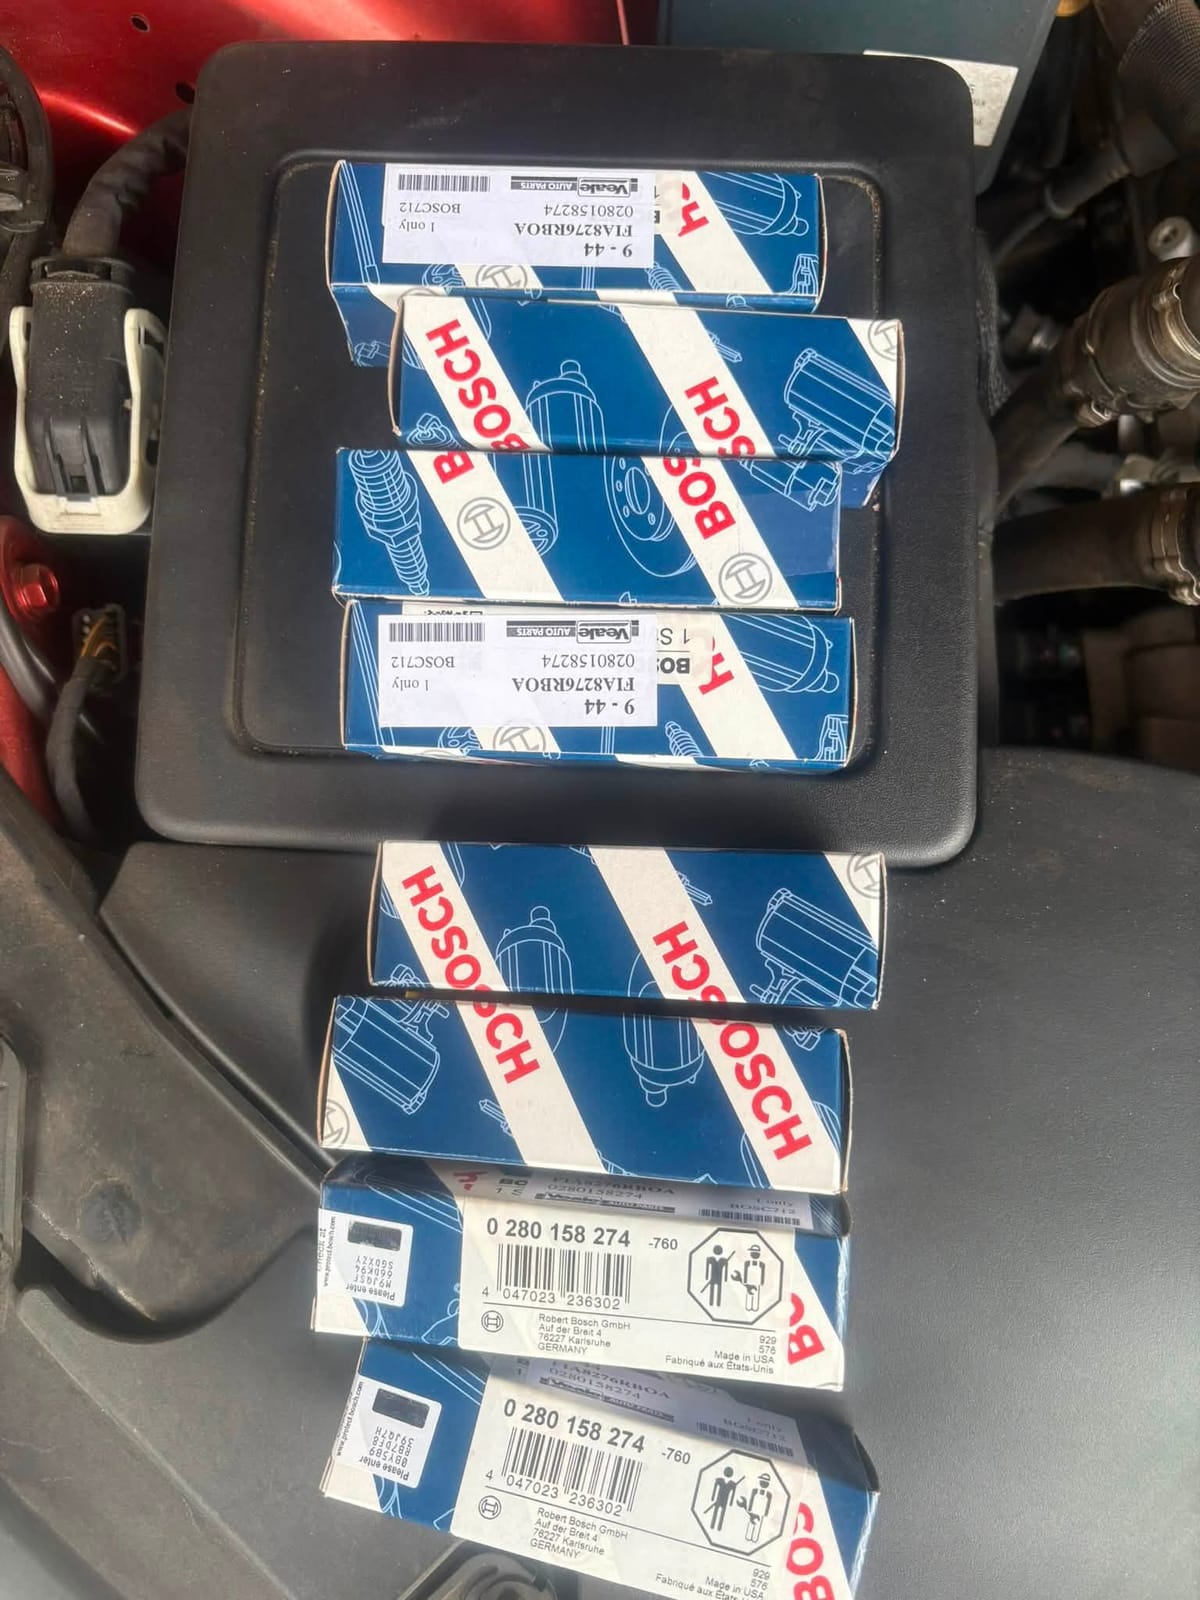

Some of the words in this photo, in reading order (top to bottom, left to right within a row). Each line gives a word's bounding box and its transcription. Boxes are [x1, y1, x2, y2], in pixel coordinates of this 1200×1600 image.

[520, 182, 545, 190] PARTS
[546, 182, 573, 191] AUTO
[581, 179, 629, 195] Veale
[399, 202, 461, 214] BOSC712
[543, 204, 634, 218] 0280158274
[399, 219, 426, 232] only
[514, 222, 633, 237] FIA8276RBOA
[584, 242, 606, 256] 44
[622, 243, 633, 257] 9
[517, 627, 541, 637] PARTS
[542, 627, 571, 637] AUTO
[578, 625, 630, 641] Veale
[391, 655, 455, 669] BOSC712
[541, 653, 635, 668] 0280158274
[391, 677, 419, 691] only
[511, 677, 635, 692] FIA8276RBOA
[584, 699, 606, 715] 44
[624, 701, 635, 716] 9
[486, 1217, 499, 1236] 0
[505, 1219, 542, 1239] 280
[549, 1222, 586, 1244] 158
[592, 1226, 631, 1247] 274
[648, 1237, 678, 1250] -760
[345, 1282, 368, 1294] enter
[369, 1288, 396, 1301] Please
[482, 1288, 490, 1298] 4
[503, 1288, 556, 1304] 047023
[566, 1295, 621, 1310] 236302
[538, 1313, 569, 1326] Robert
[571, 1316, 599, 1328] Bosch
[601, 1319, 631, 1330] GmbH
[538, 1323, 553, 1333] Auf
[555, 1325, 571, 1335] der
[573, 1326, 594, 1337] Breit
[538, 1332, 568, 1344] 76227
[569, 1335, 611, 1348] Karlsruhe
[759, 1335, 777, 1345] 929
[537, 1342, 588, 1355] GERMANY
[713, 1350, 740, 1361] Made
[742, 1352, 751, 1361] in
[753, 1353, 775, 1364] USA
[665, 1355, 706, 1368] Fabriqué
[707, 1361, 724, 1370] aux
[726, 1360, 775, 1375] États-Unis
[503, 1397, 517, 1418] 0
[521, 1403, 560, 1430] 280
[566, 1415, 603, 1442] 158
[607, 1426, 646, 1454] 274
[358, 1455, 381, 1469] enter
[660, 1446, 691, 1465] -760
[382, 1462, 410, 1481] Please
[485, 1469, 494, 1482] 4
[505, 1473, 559, 1500] 047023
[568, 1492, 623, 1518] 236302
[535, 1517, 550, 1530] Auf
[552, 1521, 566, 1534] der
[568, 1525, 590, 1540] Breit
[537, 1506, 568, 1525] Robert
[569, 1513, 599, 1530] Bosch
[599, 1523, 629, 1541] GmbH
[530, 1538, 581, 1560] GERMANY
[532, 1527, 563, 1543] 76227
[565, 1535, 605, 1557] Karlsruhe
[655, 1572, 696, 1592] Fabriqué
[696, 1585, 714, 1598] aux
[704, 1575, 731, 1592] Made
[732, 1583, 742, 1594] in
[743, 1585, 765, 1600] USA
[750, 1578, 769, 1592] 576
